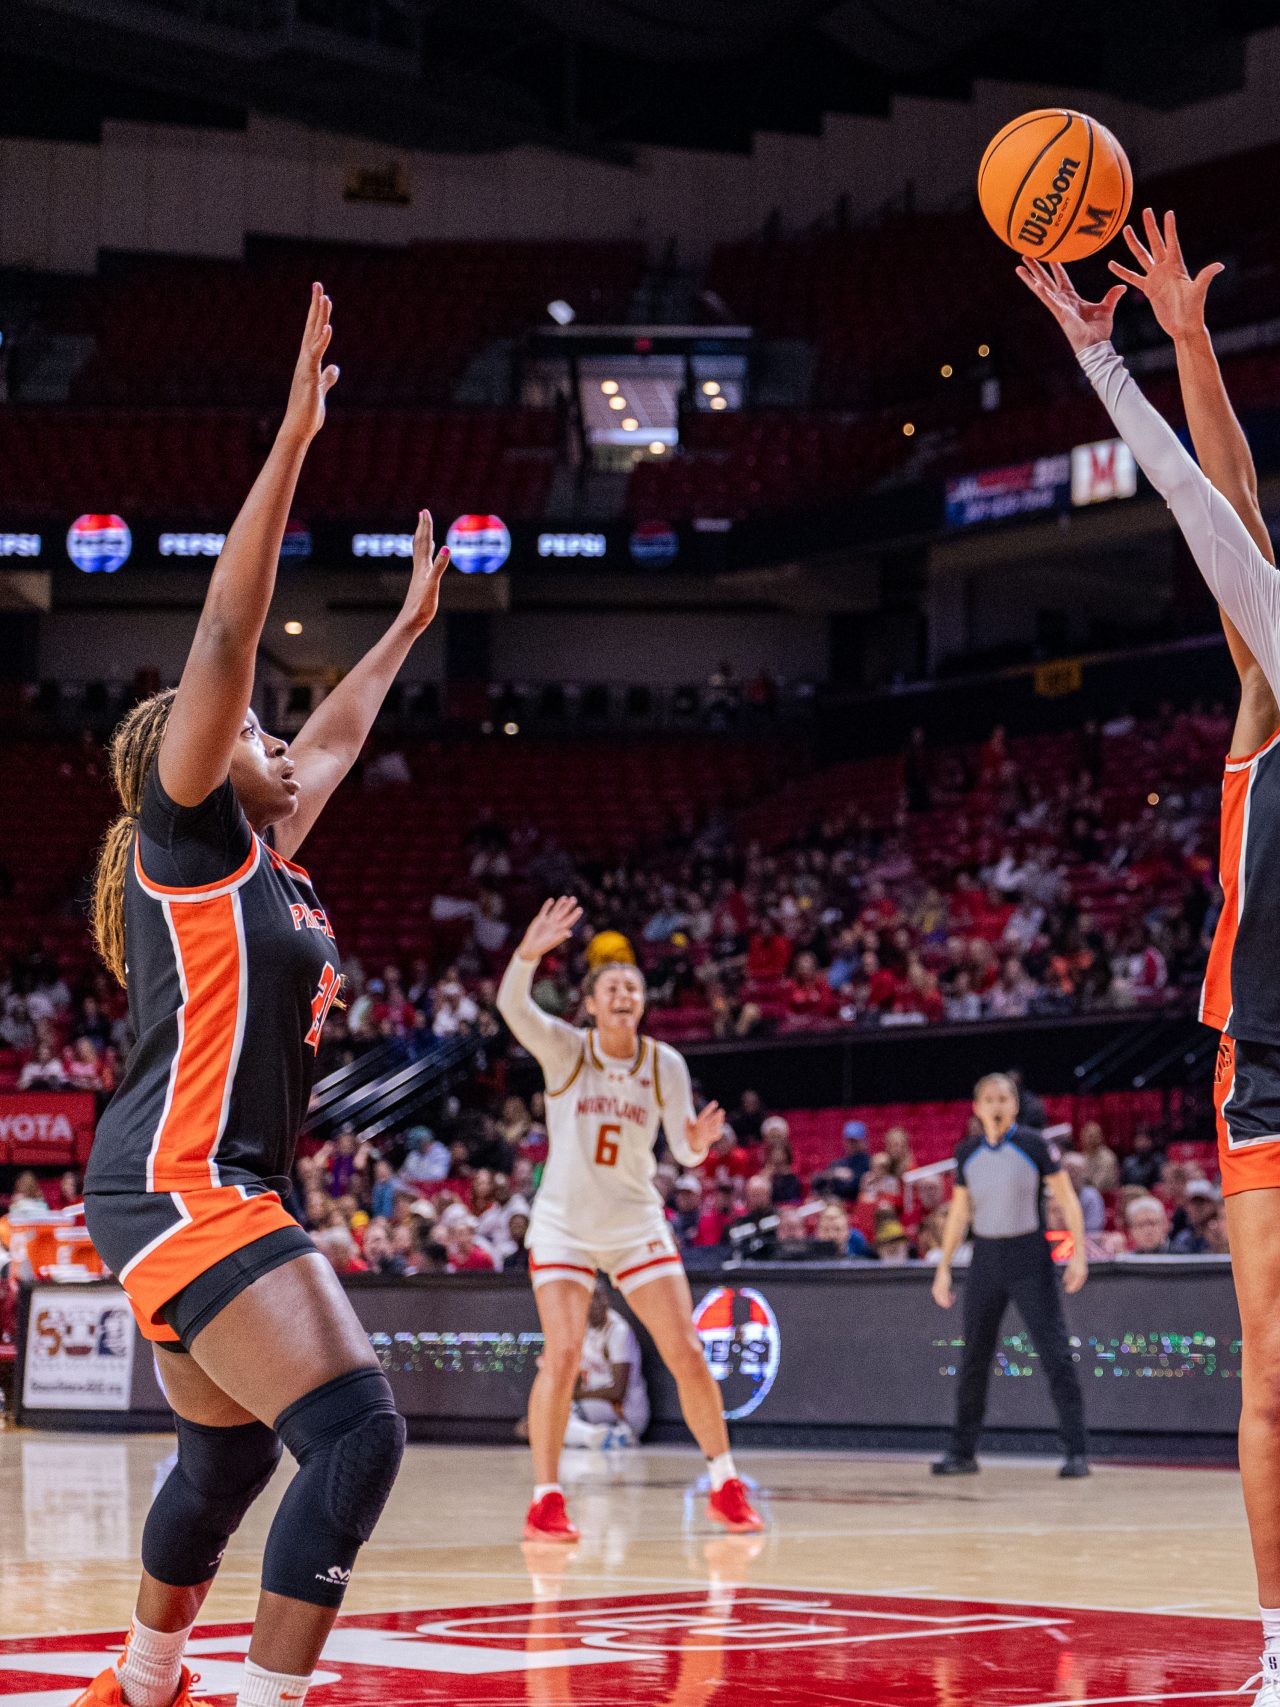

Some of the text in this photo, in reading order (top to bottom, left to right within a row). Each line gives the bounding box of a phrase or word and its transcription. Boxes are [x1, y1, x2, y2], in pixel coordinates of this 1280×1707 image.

[1017, 157, 1081, 246] Wilson
[1074, 204, 1118, 238] M
[537, 532, 606, 557] PEPSI
[595, 1123, 622, 1168] 6
